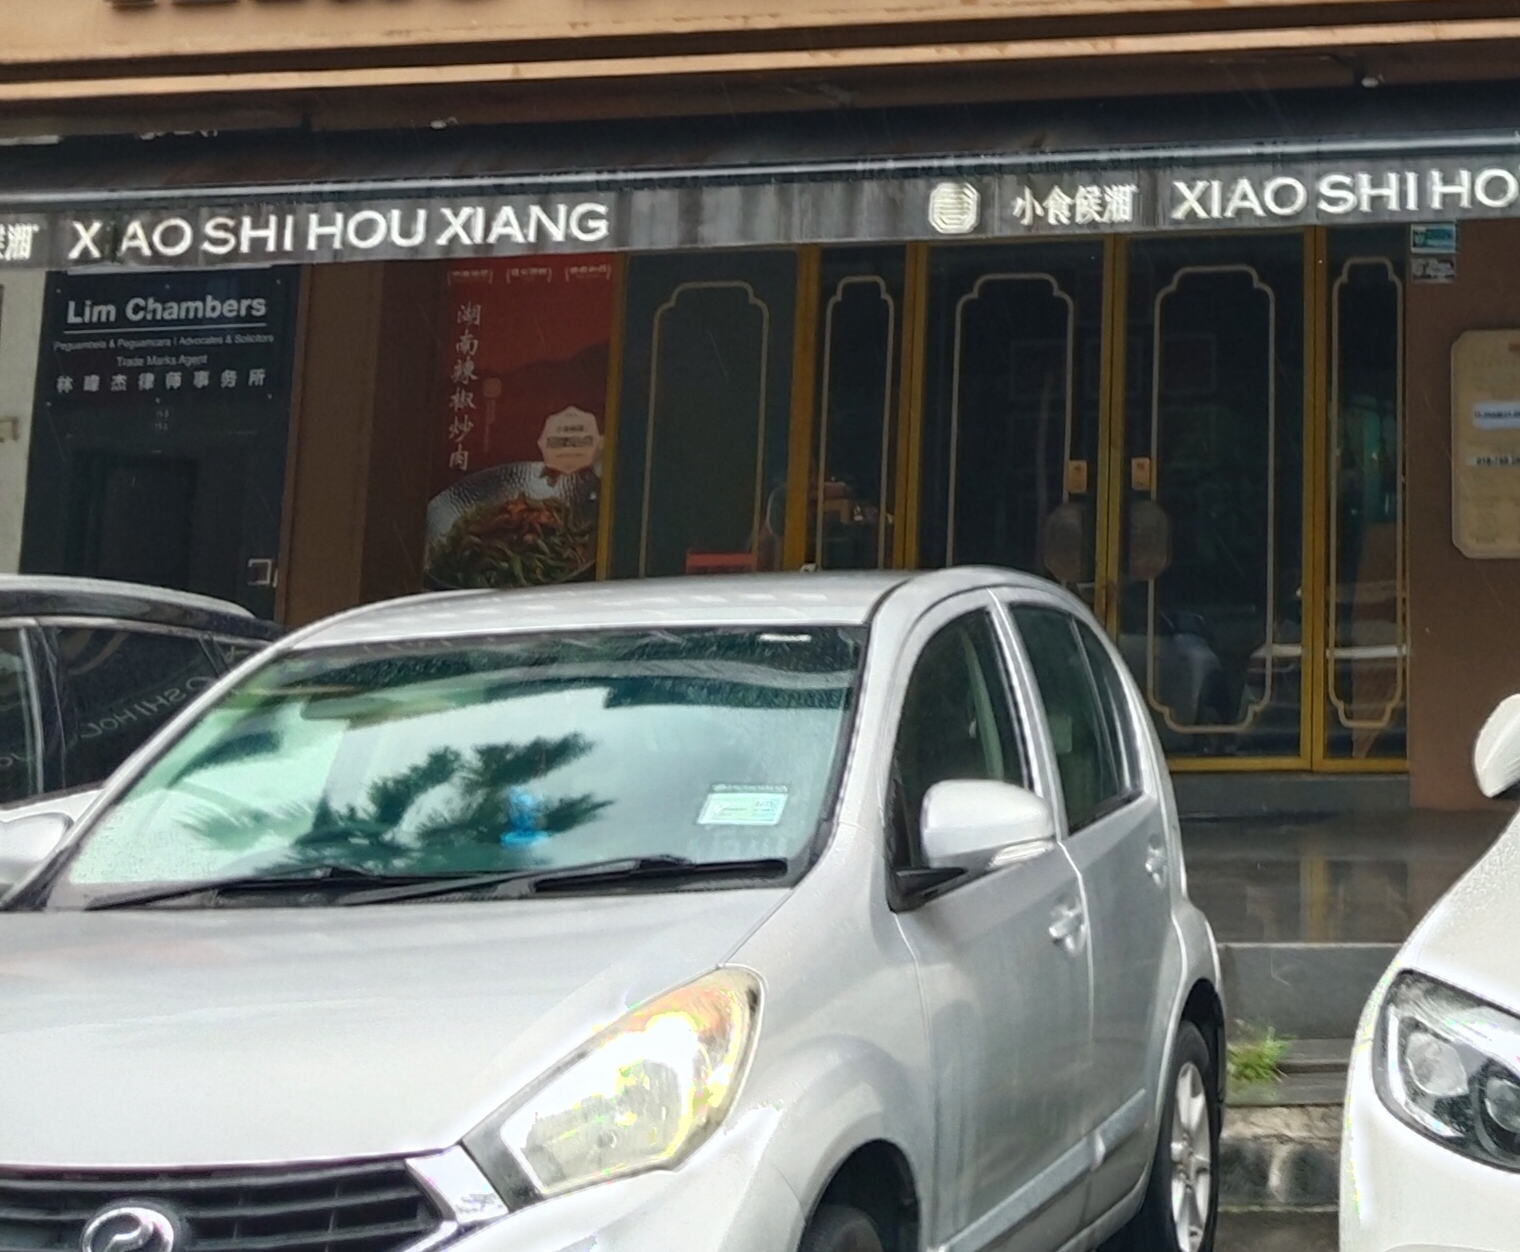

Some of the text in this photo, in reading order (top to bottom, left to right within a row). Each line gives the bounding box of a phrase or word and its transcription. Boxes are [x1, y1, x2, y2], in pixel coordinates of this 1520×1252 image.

[1171, 175, 1308, 221] XIAO
[1317, 170, 1419, 214] SHI
[201, 213, 295, 256] SHI
[307, 207, 427, 251] HOU
[435, 201, 610, 246] XIANG
[67, 294, 268, 325] Lim Chambers
[116, 355, 144, 368] Trade
[178, 353, 208, 368] Agent
[179, 335, 224, 346] Advocates
[448, 299, 482, 473] 湖南辣椒炒肉
